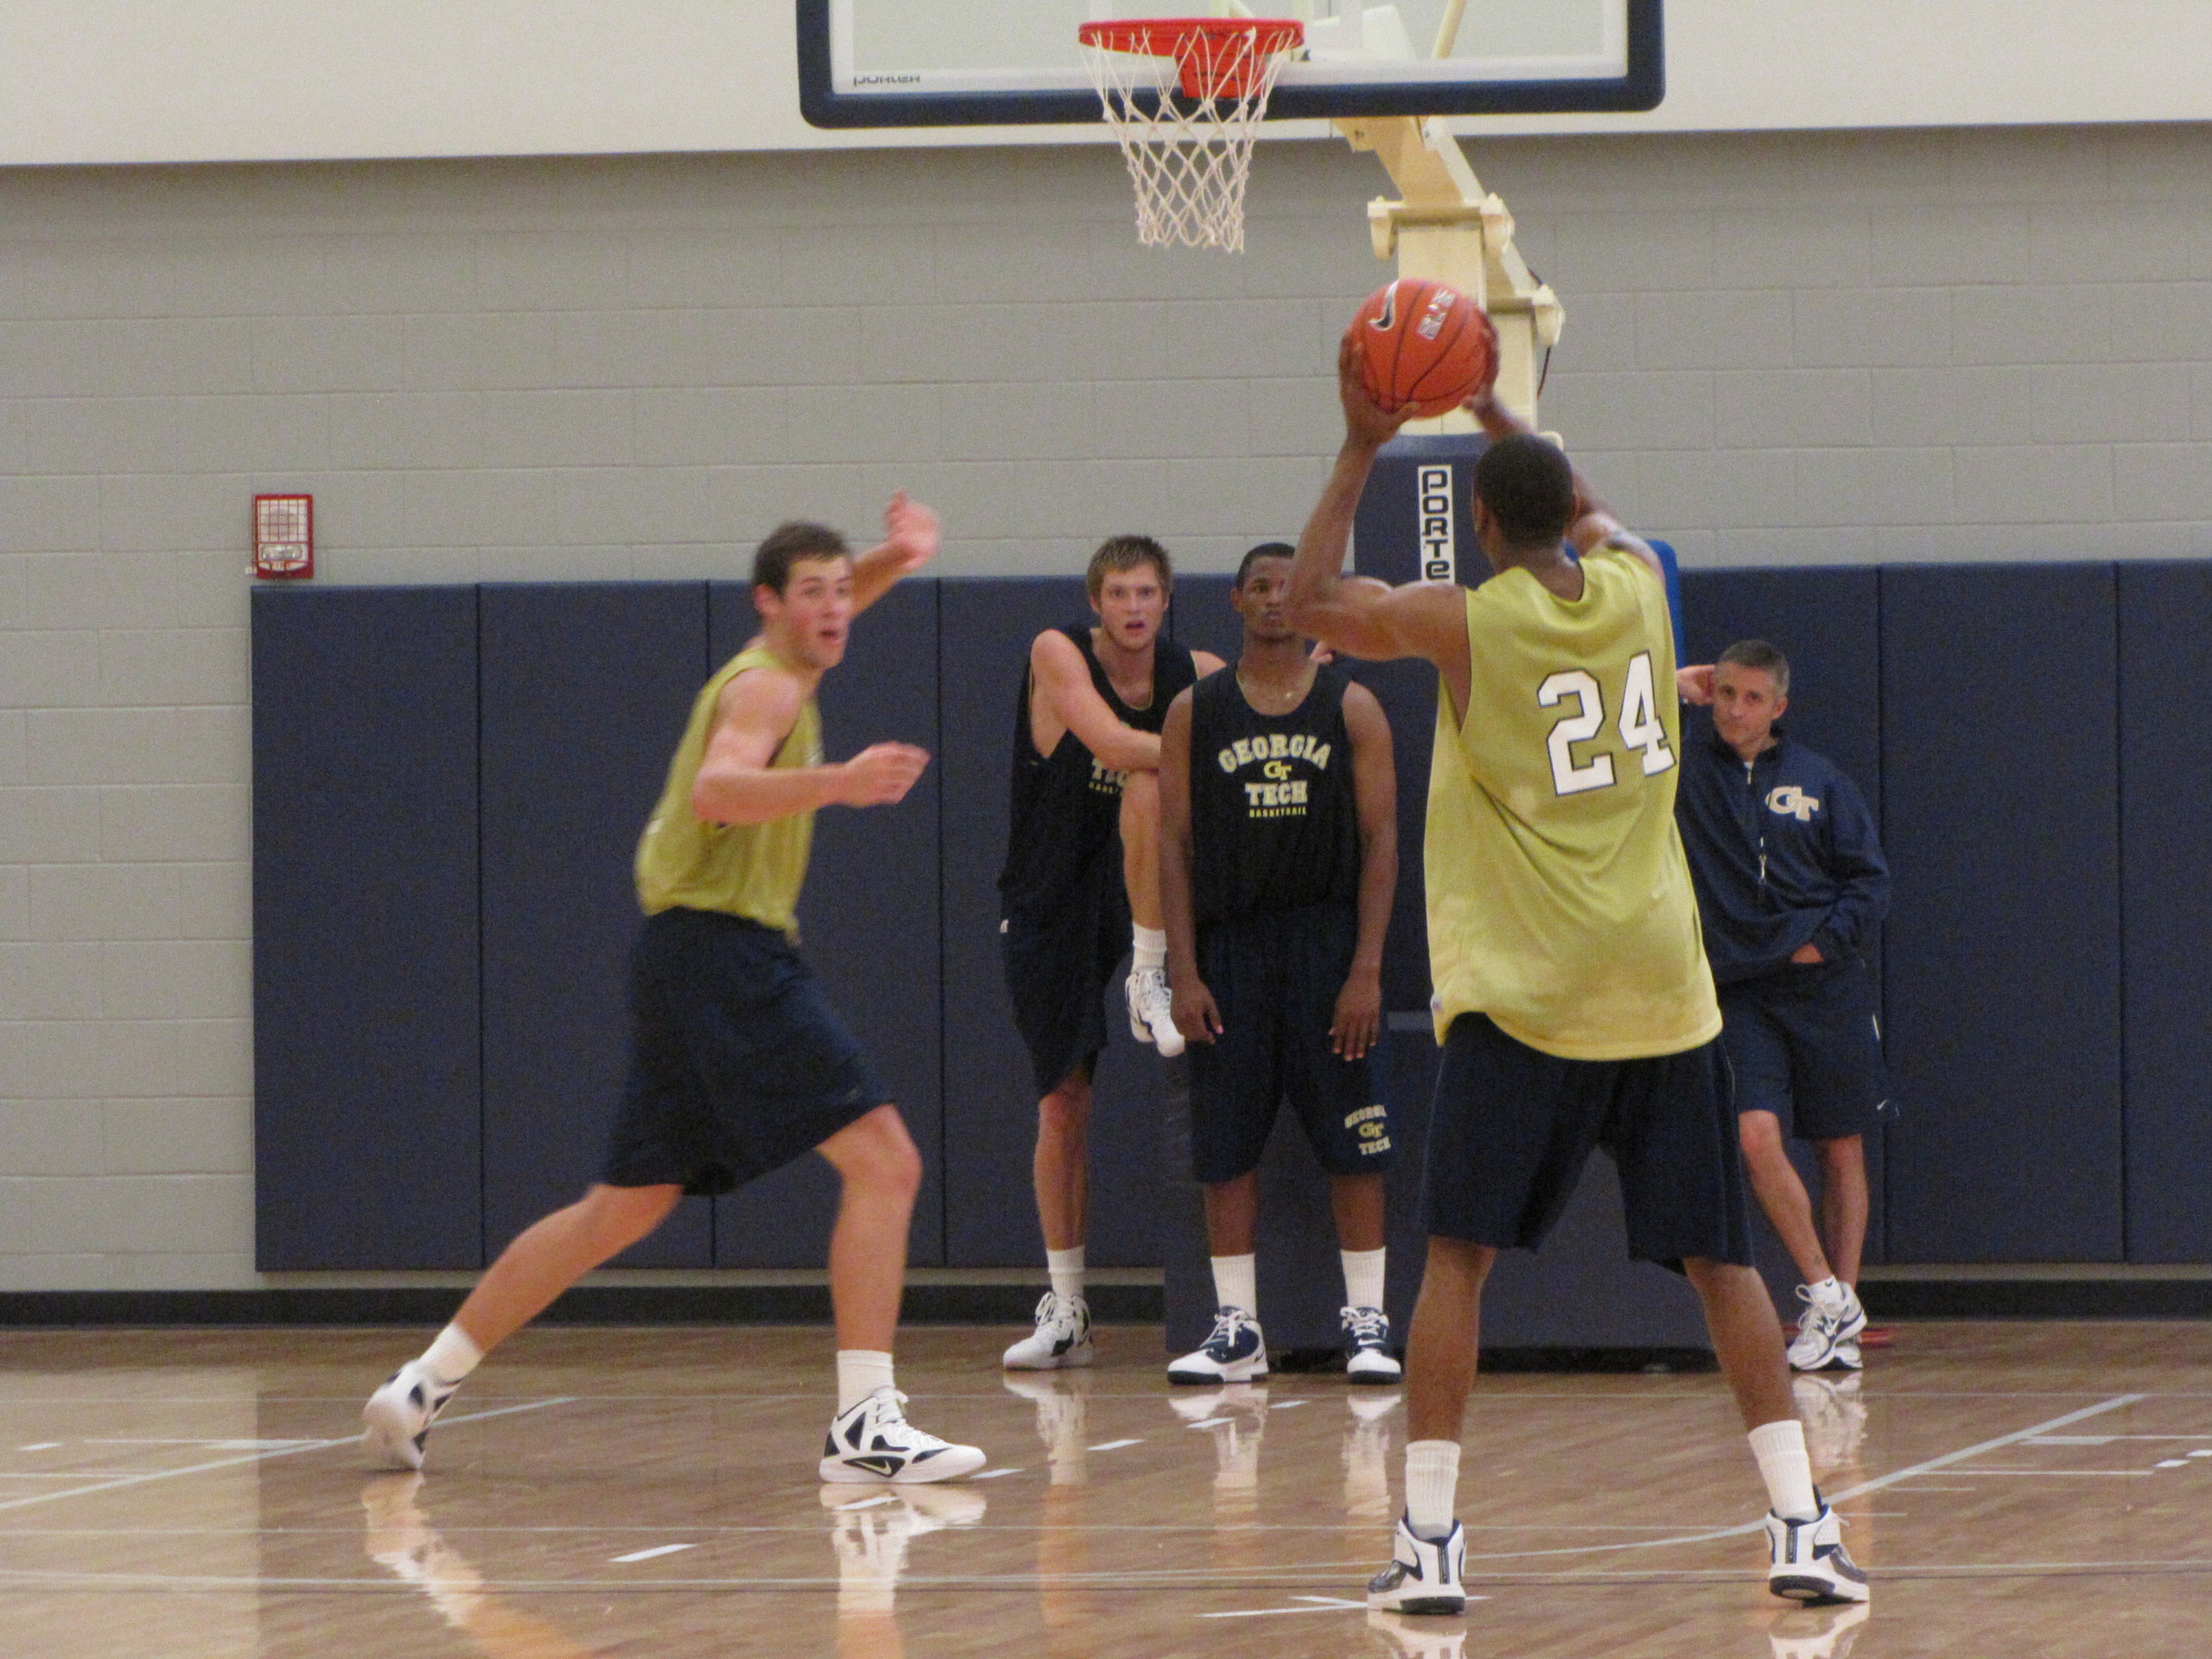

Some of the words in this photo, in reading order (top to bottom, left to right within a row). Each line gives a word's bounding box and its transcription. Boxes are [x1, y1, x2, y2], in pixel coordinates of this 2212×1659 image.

[1537, 649, 1677, 796] 24
[1218, 733, 1332, 773] GEORGIA
[1263, 760, 1292, 780] GT
[1245, 780, 1308, 806] TECH
[1765, 786, 1820, 822] GT
